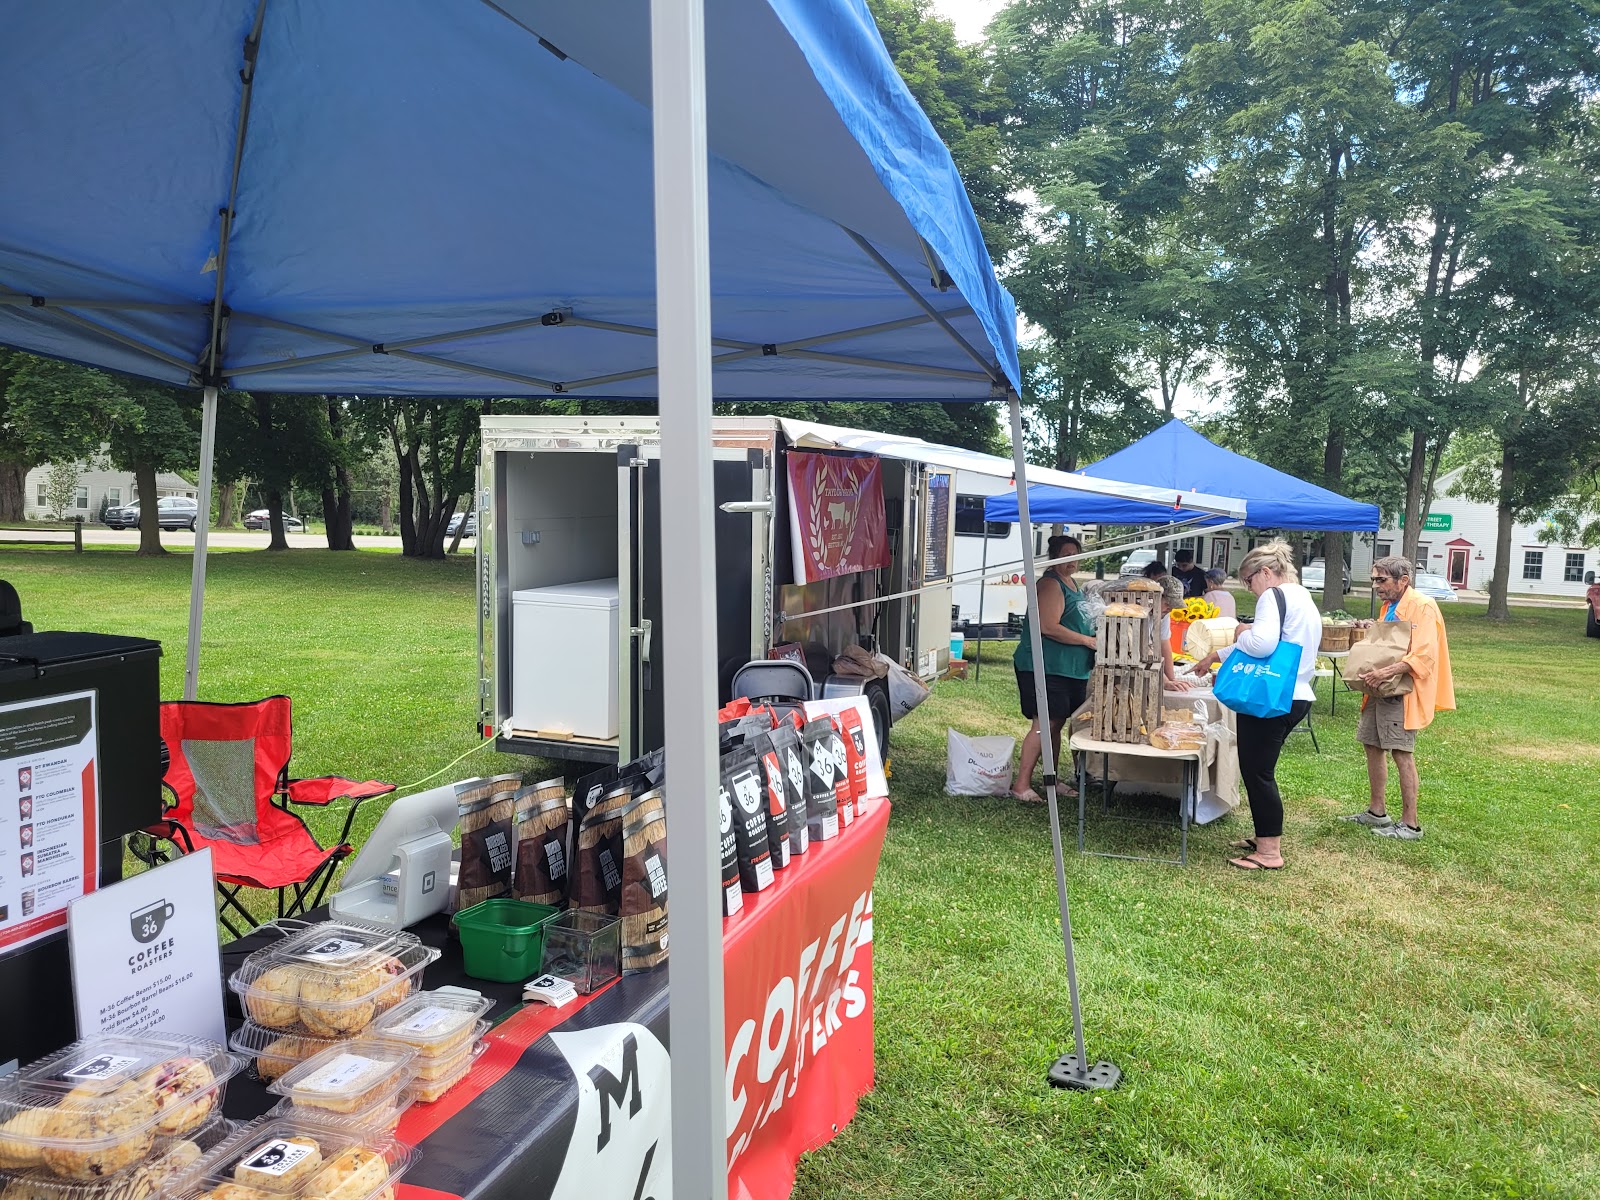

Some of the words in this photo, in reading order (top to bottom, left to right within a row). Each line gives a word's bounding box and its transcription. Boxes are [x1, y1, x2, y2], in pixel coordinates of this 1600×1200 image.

[815, 745, 822, 755] M
[835, 747, 846, 766] 36
[791, 765, 802, 785] 36
[817, 757, 832, 776] 36
[46, 787, 75, 798] COLOMBIAN
[743, 793, 755, 806] 36
[47, 813, 75, 825] HONDURAN
[37, 842, 67, 854] INDONESIAN
[37, 850, 60, 860] SUMATRA
[490, 851, 511, 873] COFFEE
[549, 859, 566, 881] COFFEE
[37, 881, 61, 893] BOURBON
[62, 875, 80, 885] BARREL
[651, 874, 668, 899] COFFEE
[145, 914, 152, 923] M
[141, 920, 157, 938] 36
[128, 937, 175, 966] COFFEE
[131, 949, 173, 975] ROASTERS
[99, 1003, 116, 1015] M-36
[116, 994, 135, 1007] Coffee
[135, 986, 152, 997] Beans
[152, 974, 172, 989] $15.00
[100, 1012, 116, 1025] M-36
[117, 1000, 141, 1017] Bourbon
[141, 990, 158, 1004] Barrel
[158, 984, 175, 995] Beans
[116, 1015, 131, 1026] Brew
[131, 1005, 149, 1019] $4.00
[140, 1008, 160, 1023] $12.00
[149, 1014, 166, 1028] $4.00
[586, 1031, 643, 1155] M
[263, 1154, 280, 1165] 36
[272, 1149, 302, 1170] COFFEE
